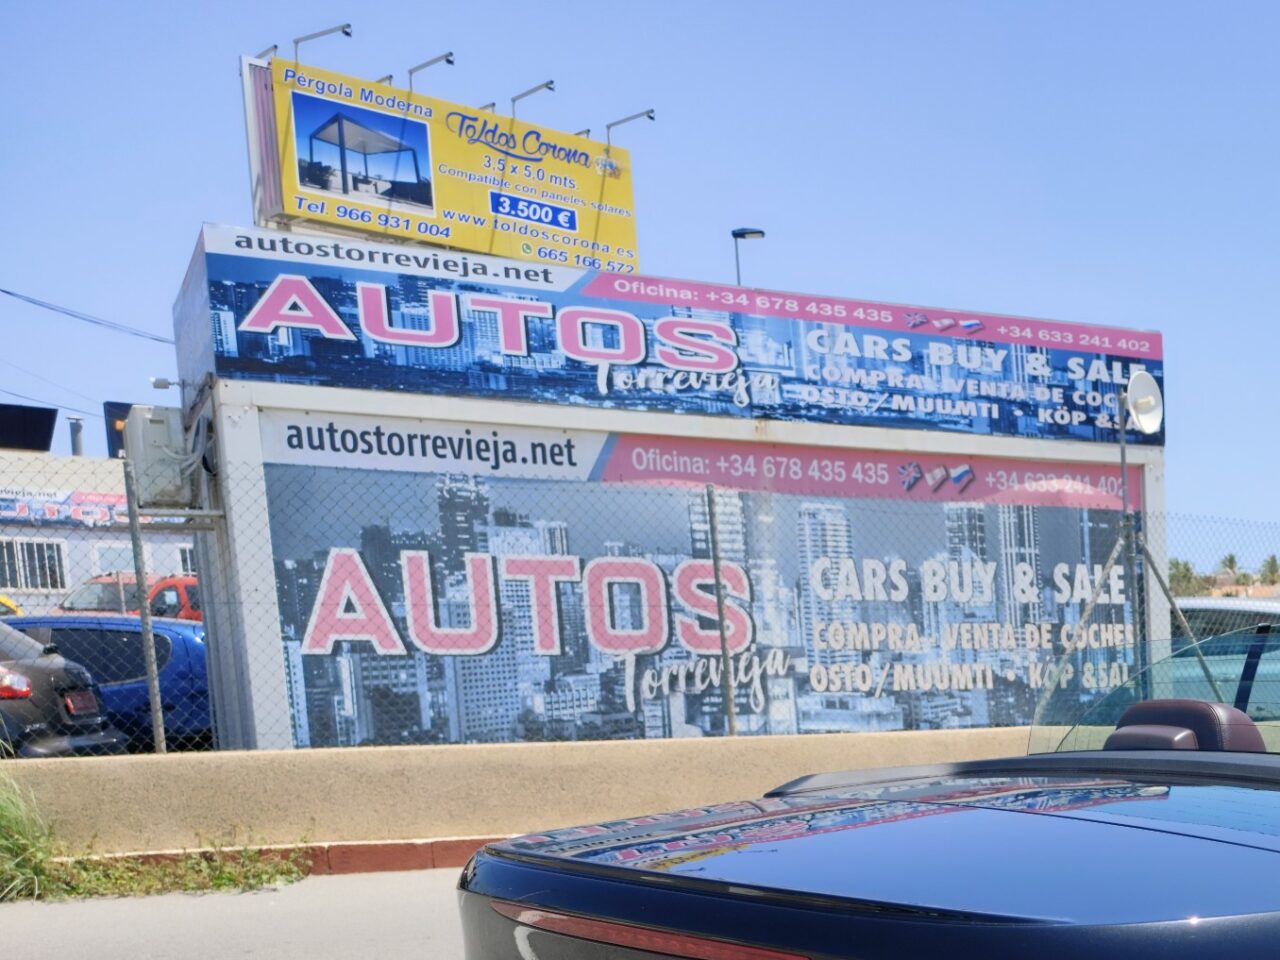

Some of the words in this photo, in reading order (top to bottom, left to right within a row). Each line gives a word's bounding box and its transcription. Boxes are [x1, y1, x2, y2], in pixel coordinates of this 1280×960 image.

[284, 69, 352, 97] Pérgola
[360, 88, 433, 117] Moderna
[446, 112, 516, 149] Toldos
[522, 130, 591, 168] Corona
[438, 163, 511, 189] Compatible
[515, 183, 537, 195] con
[541, 187, 586, 206] paneles
[591, 201, 631, 217] solares
[498, 197, 552, 223] 3.500
[557, 211, 571, 227] €
[336, 205, 372, 223] 966
[377, 213, 411, 231] 931
[417, 222, 451, 238] 004
[443, 209, 634, 258] www.toldoscorona.es
[235, 234, 554, 286] autostorrevieja.net
[537, 246, 568, 263] 665
[575, 254, 602, 269] 166
[607, 261, 634, 273] 572
[238, 273, 741, 374] AUTOS
[614, 279, 698, 300] Oficina:
[706, 291, 749, 306] +34
[756, 296, 799, 312] 678
[806, 301, 847, 317] 435
[852, 306, 894, 322] 435
[807, 329, 912, 361] CARS
[929, 341, 1008, 371] BUY
[1027, 352, 1051, 377] &
[997, 325, 1032, 340] +34
[1038, 329, 1073, 344] 633
[1079, 334, 1112, 348] 241
[1117, 339, 1150, 353] 402
[597, 359, 780, 408] Torrevieja
[806, 364, 922, 389] COMPRA
[948, 378, 1025, 402] VENTA
[1034, 386, 1064, 404] DE
[1038, 405, 1086, 425] KÖP
[286, 422, 578, 471] autostorrevieja.net
[632, 447, 711, 475] Oficina:
[715, 456, 757, 477] +34
[762, 457, 802, 480] 678
[808, 460, 847, 483] 435
[850, 462, 889, 486] 435
[985, 471, 1019, 491] +34
[1024, 473, 1059, 492] 633
[1064, 475, 1093, 496] 241
[300, 547, 754, 657] AUTOS
[810, 556, 909, 602] CARS
[922, 560, 997, 603] BUY
[1014, 562, 1040, 604] &
[1054, 563, 1126, 604] SALE
[812, 623, 921, 650] COMPRA
[944, 623, 1016, 649] VENTA
[1025, 624, 1053, 649] DE
[623, 643, 789, 713] Torrevieja
